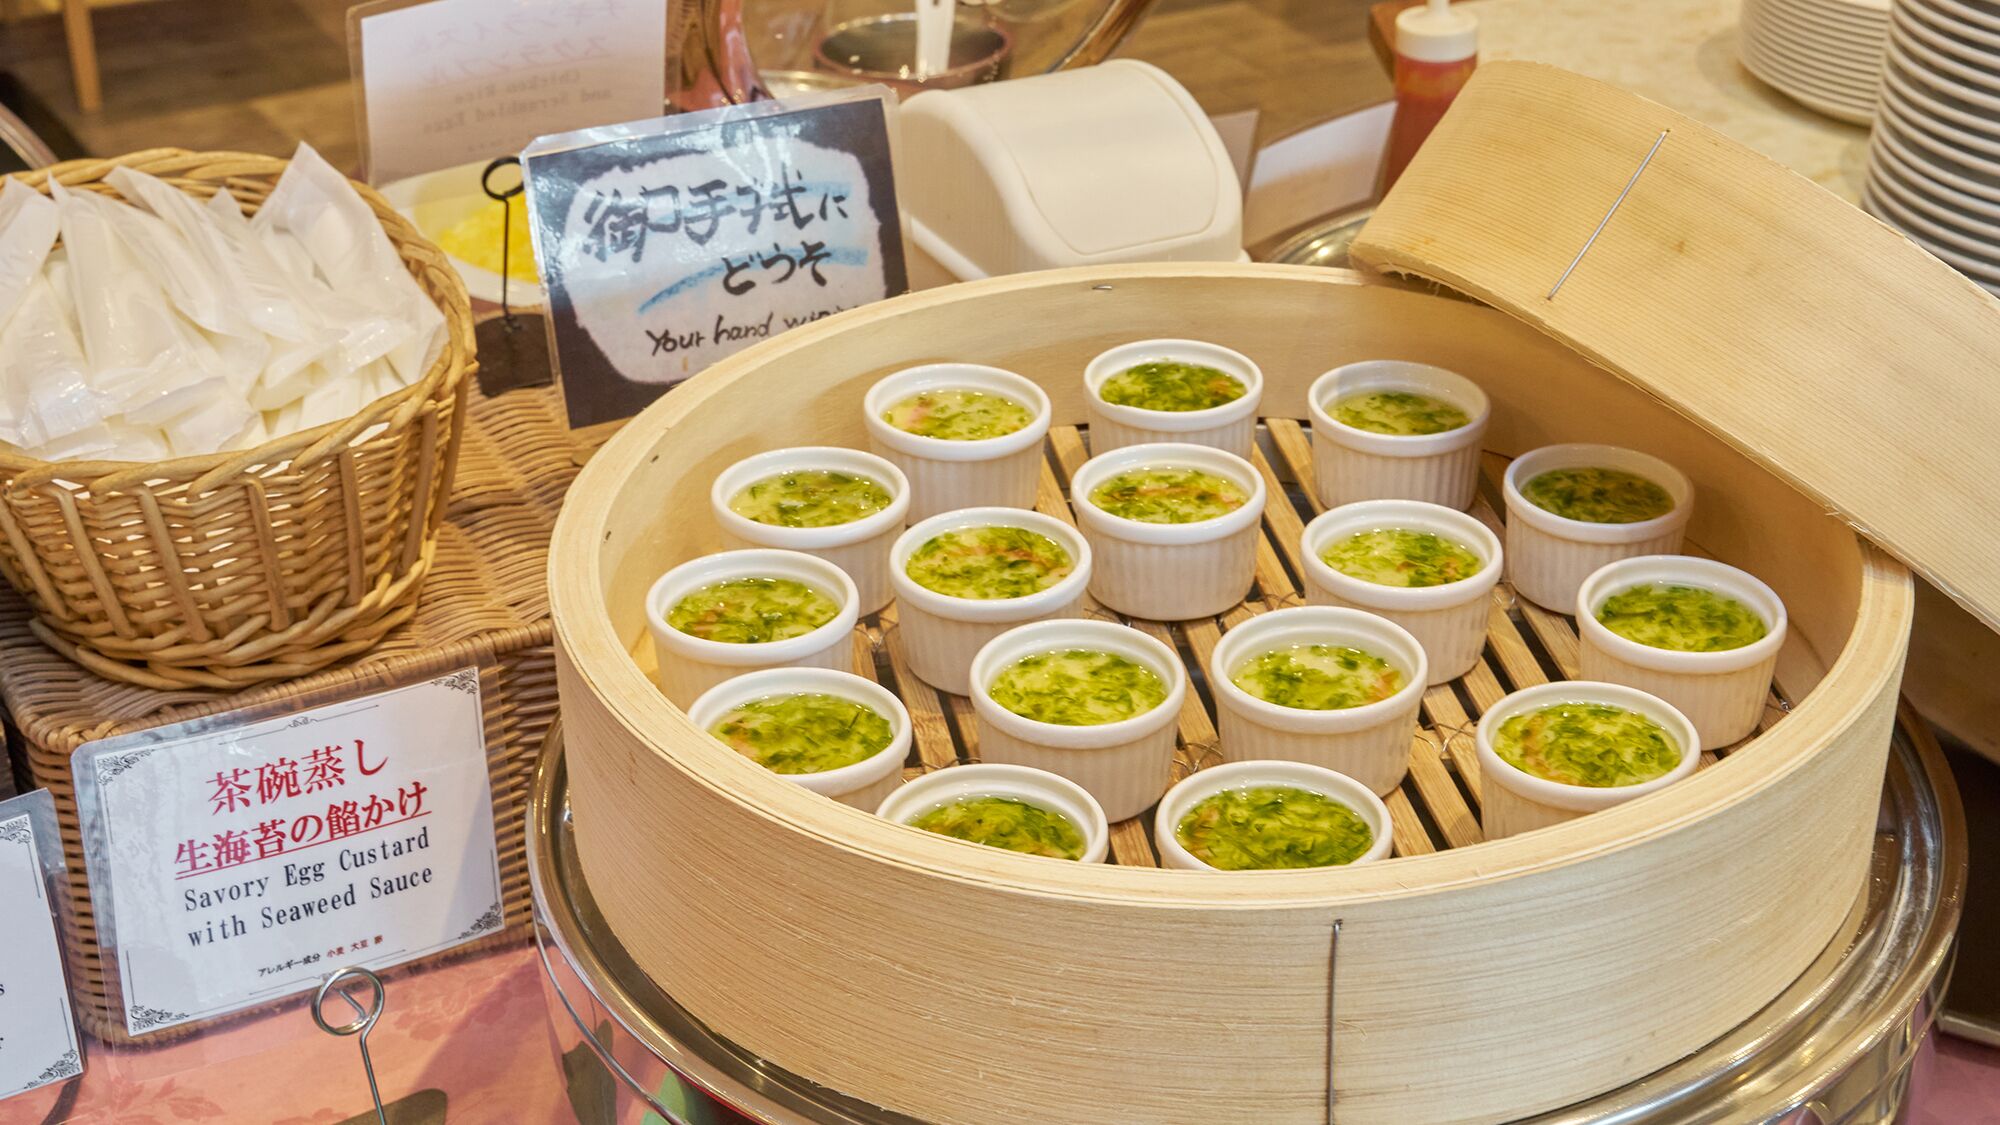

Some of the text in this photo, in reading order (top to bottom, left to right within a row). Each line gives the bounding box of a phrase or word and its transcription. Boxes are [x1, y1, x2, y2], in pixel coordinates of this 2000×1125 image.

[713, 312, 774, 345] hand
[206, 739, 389, 816] 茶碗蒸し
[174, 781, 428, 875] 生海苔の餡かけ
[184, 826, 430, 912] Savory Egg Custard
[188, 867, 433, 947] with Seaweed Sauce
[258, 953, 320, 977] アレルギー成分
[350, 939, 368, 952] 大豆
